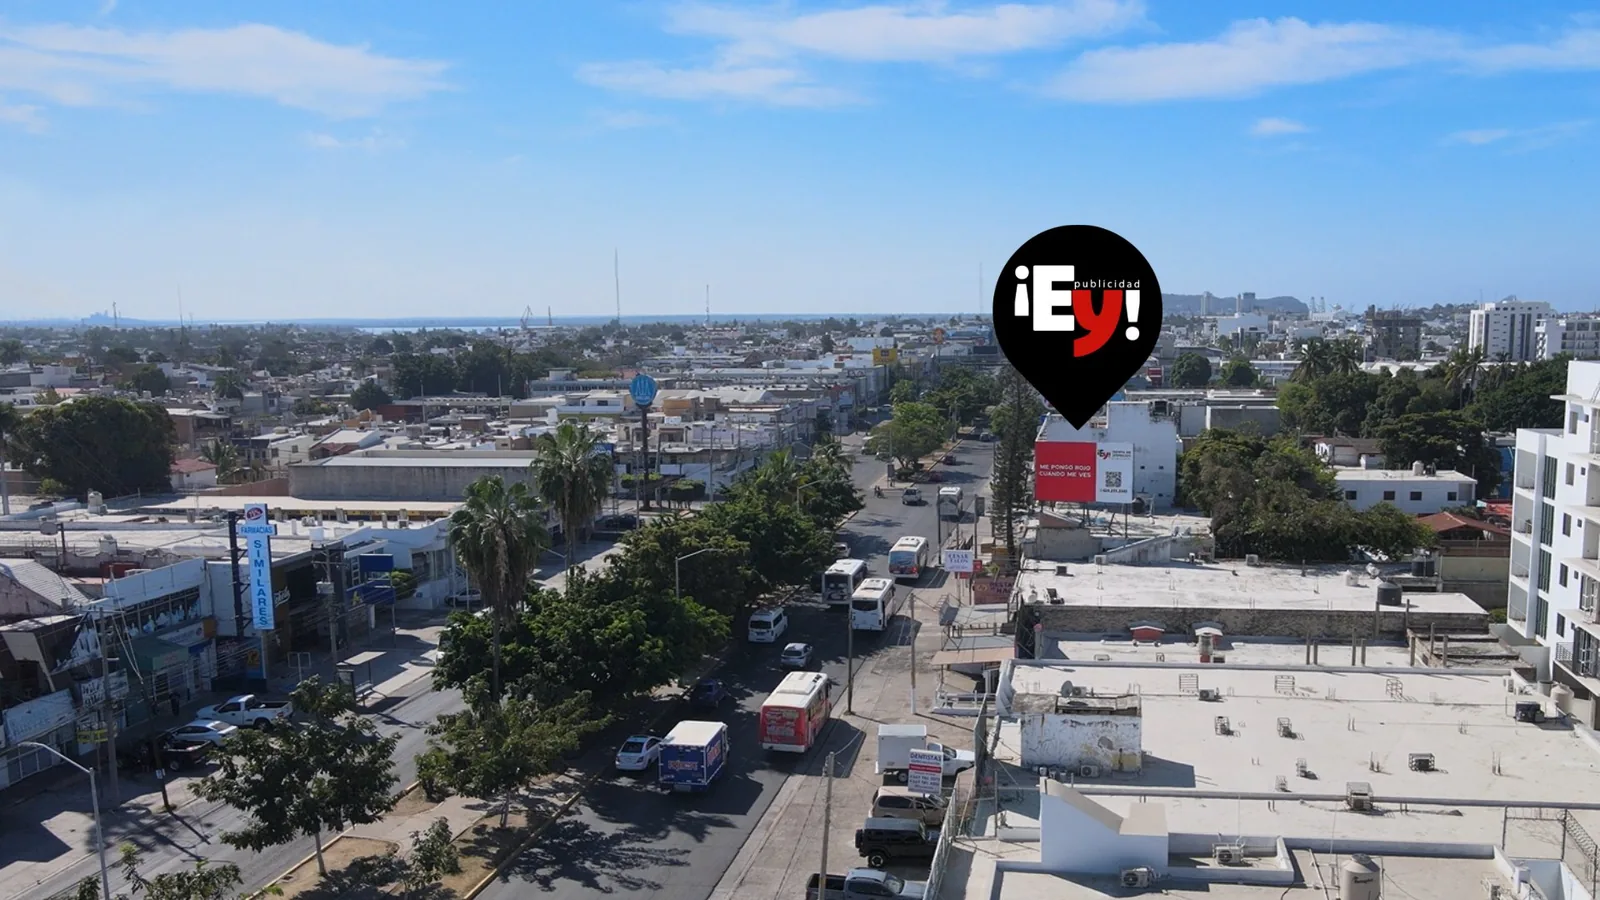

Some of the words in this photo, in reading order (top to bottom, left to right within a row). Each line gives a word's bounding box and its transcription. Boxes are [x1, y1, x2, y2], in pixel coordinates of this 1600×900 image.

[240, 526, 273, 534] FARMACIAS
[253, 539, 269, 626] SIMILARES
[910, 752, 941, 761] DENTISTAS
